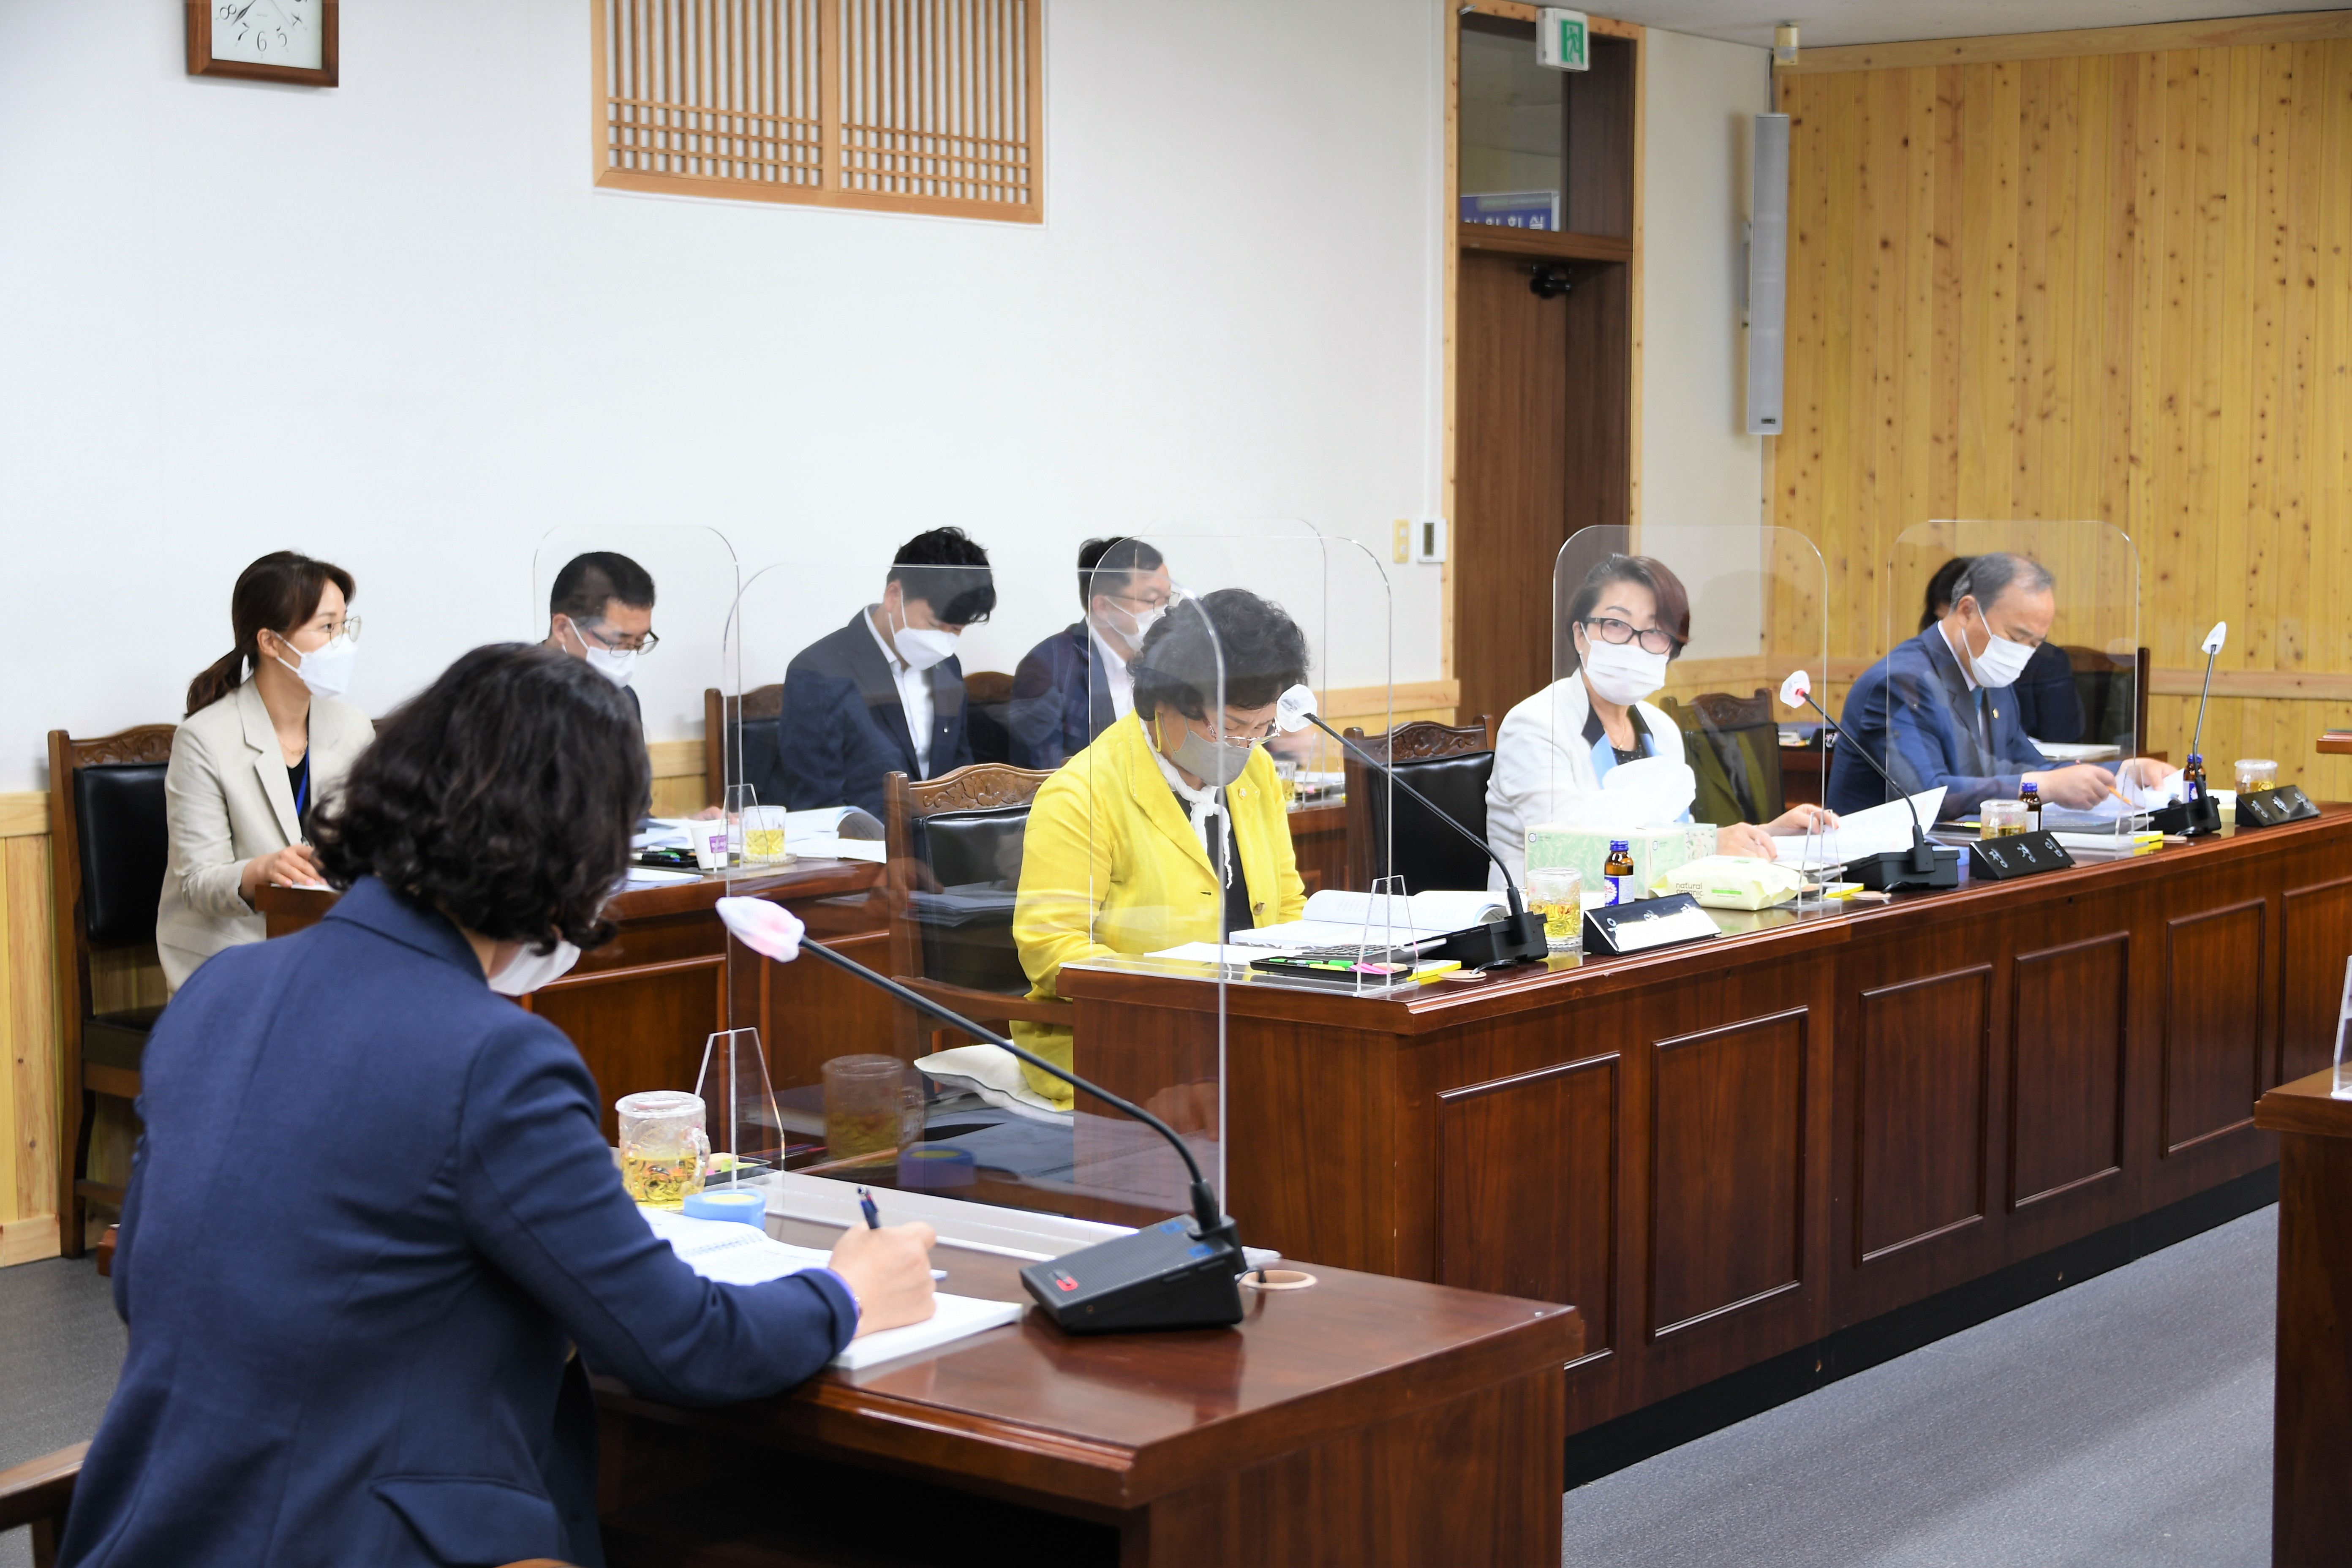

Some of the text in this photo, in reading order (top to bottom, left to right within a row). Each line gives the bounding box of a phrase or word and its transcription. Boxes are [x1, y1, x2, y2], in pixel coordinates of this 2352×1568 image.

[219, 4, 237, 20] 8
[291, 13, 303, 26] 4
[237, 22, 250, 41] 7
[276, 26, 287, 47] 5
[257, 31, 267, 52] 6
